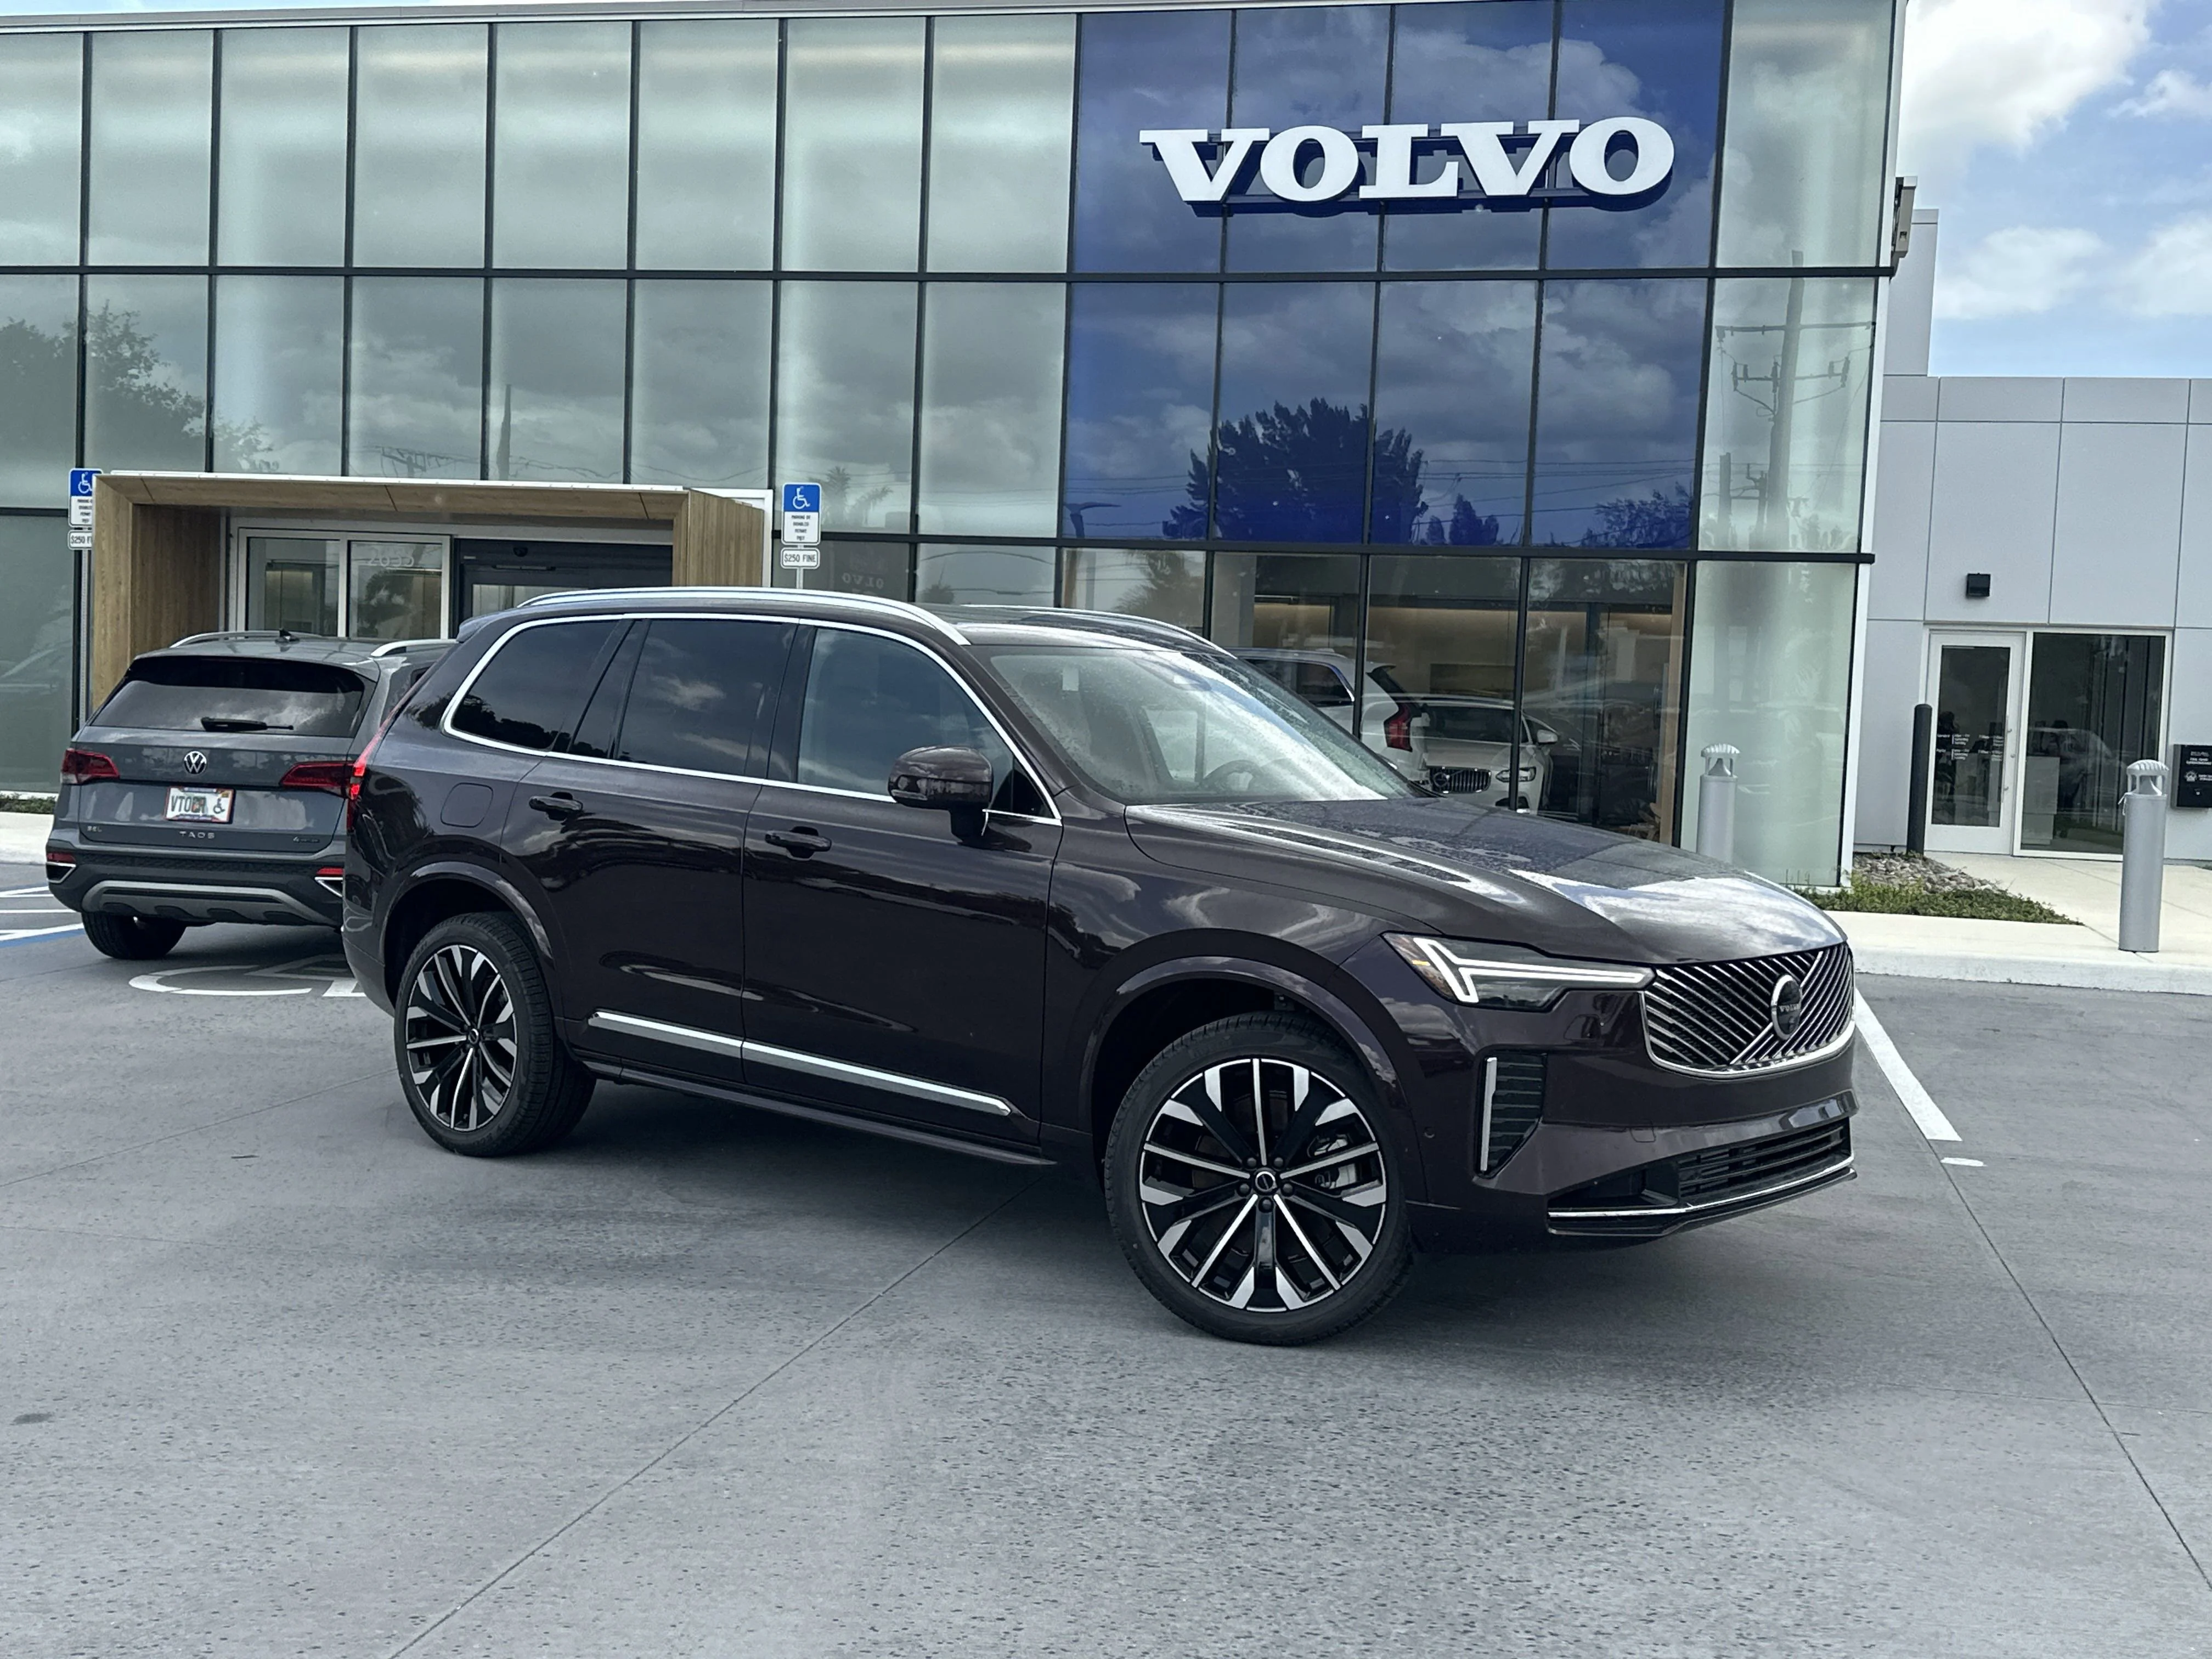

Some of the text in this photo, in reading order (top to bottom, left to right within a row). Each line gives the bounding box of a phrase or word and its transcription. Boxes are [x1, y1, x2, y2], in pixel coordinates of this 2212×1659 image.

[1139, 117, 1674, 202] VOLVO
[784, 553, 816, 563] $250 FINE
